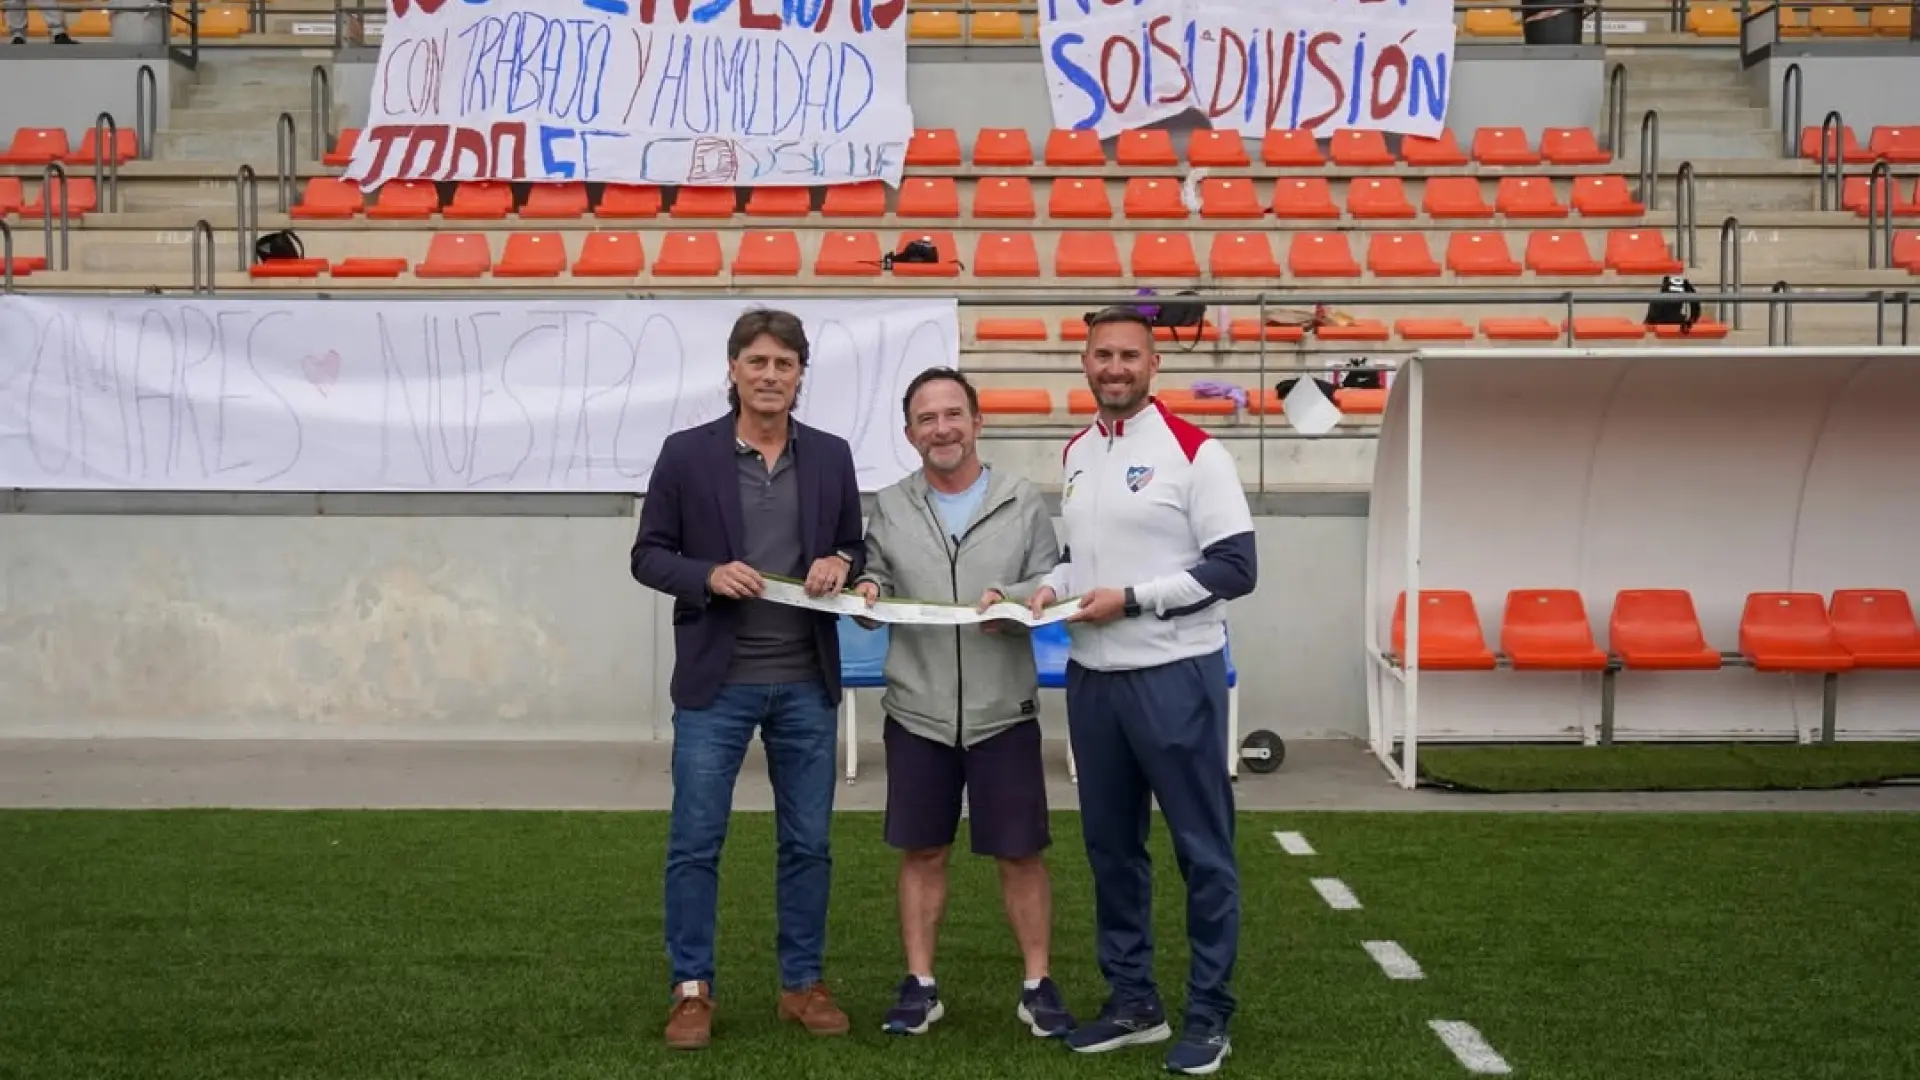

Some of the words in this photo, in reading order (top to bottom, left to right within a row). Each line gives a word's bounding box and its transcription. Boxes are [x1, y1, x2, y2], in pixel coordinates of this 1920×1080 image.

[384, 27, 449, 117] CON
[457, 11, 611, 124] TRABAJO
[622, 27, 654, 125] Y
[376, 310, 684, 486] NUESTRO
